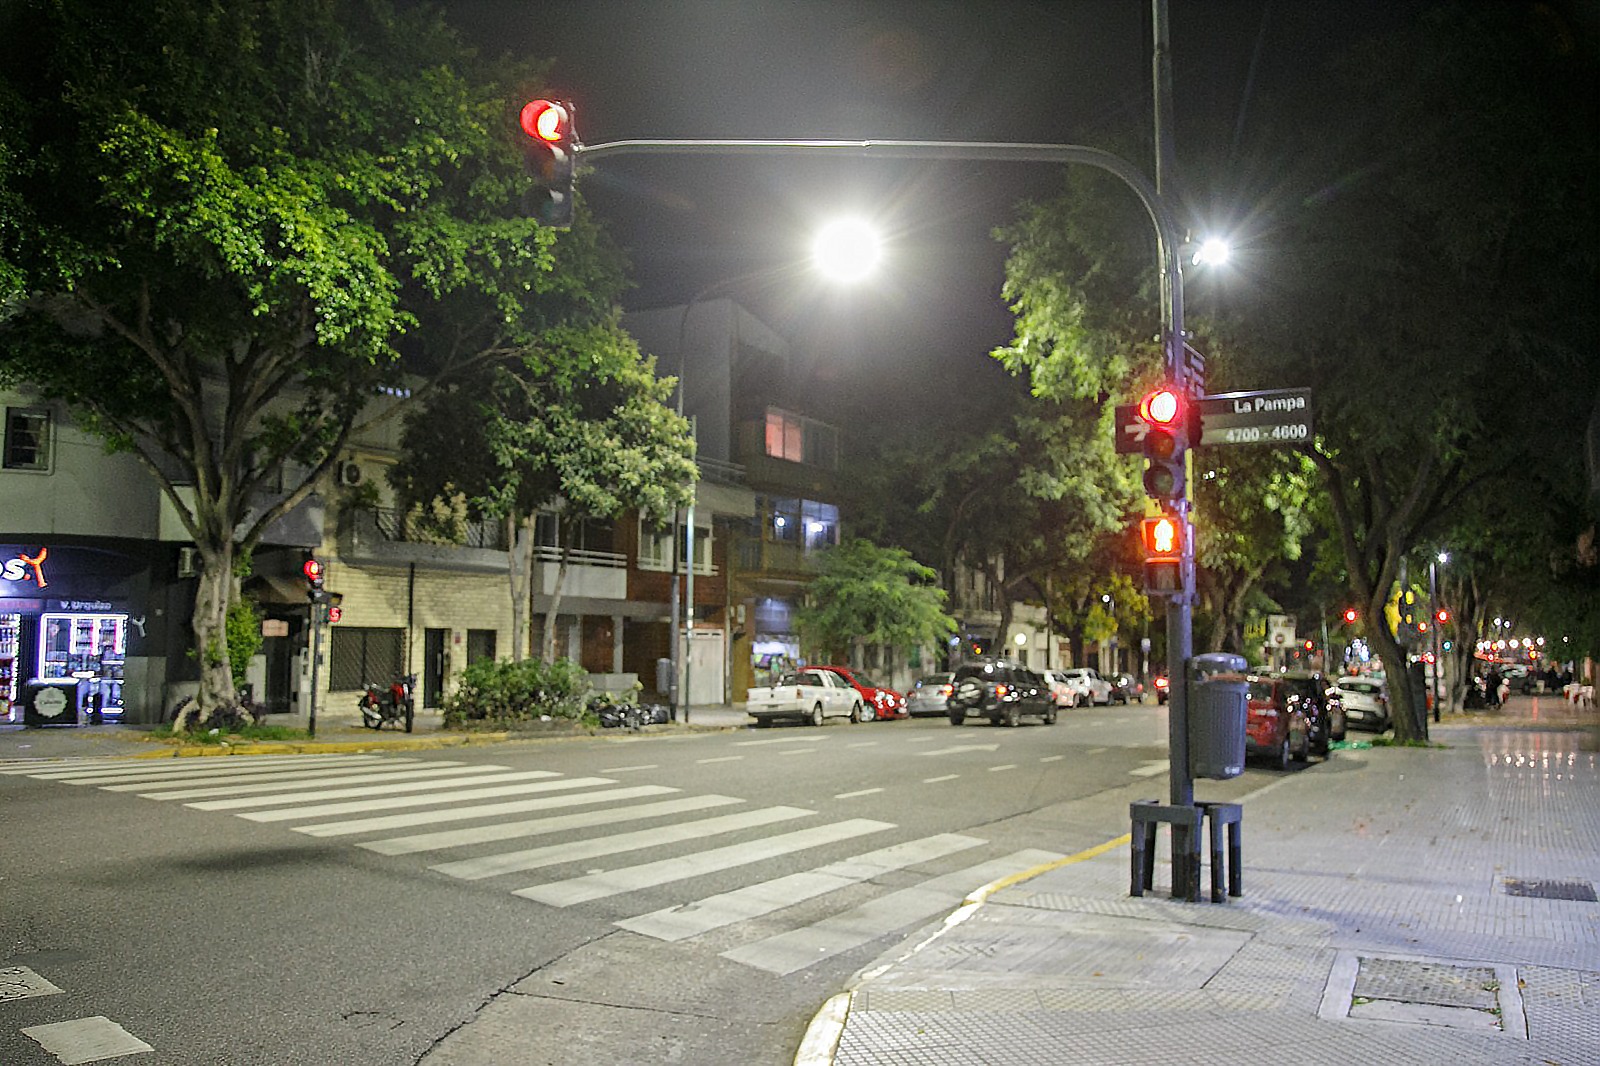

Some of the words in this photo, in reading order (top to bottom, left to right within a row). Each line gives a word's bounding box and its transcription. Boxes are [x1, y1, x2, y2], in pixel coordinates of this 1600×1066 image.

[1233, 400, 1252, 414] La
[1254, 397, 1305, 412] Pampa
[1226, 427, 1260, 443] 4700
[1272, 423, 1307, 440] 4600
